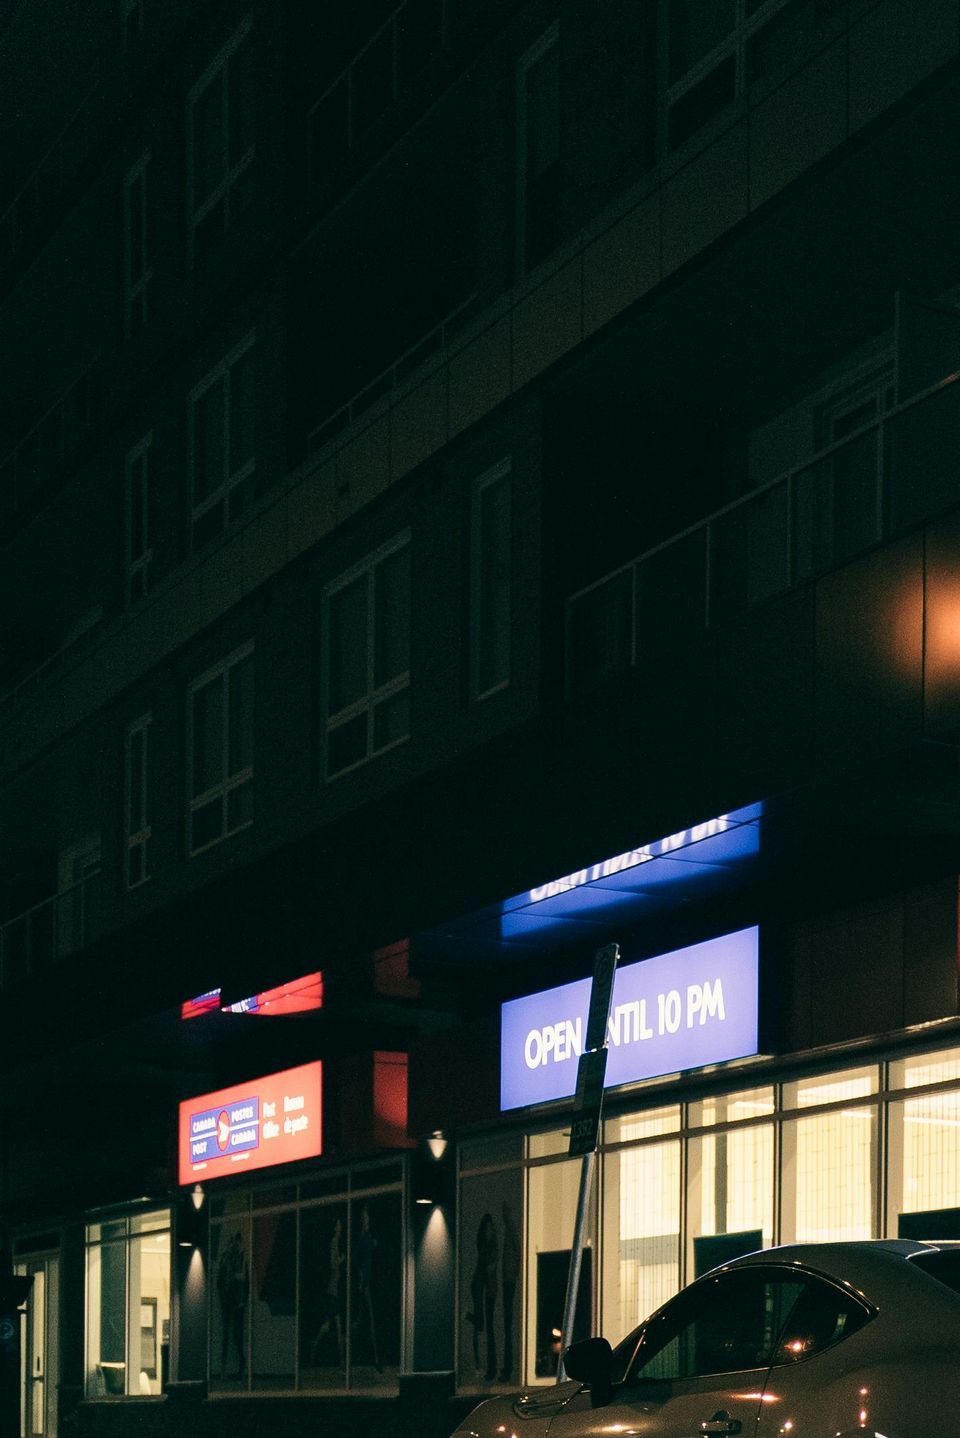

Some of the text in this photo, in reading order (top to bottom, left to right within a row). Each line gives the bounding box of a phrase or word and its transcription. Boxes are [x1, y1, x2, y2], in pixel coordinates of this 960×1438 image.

[524, 978, 726, 1069] OPEN NTIL 10 PM
